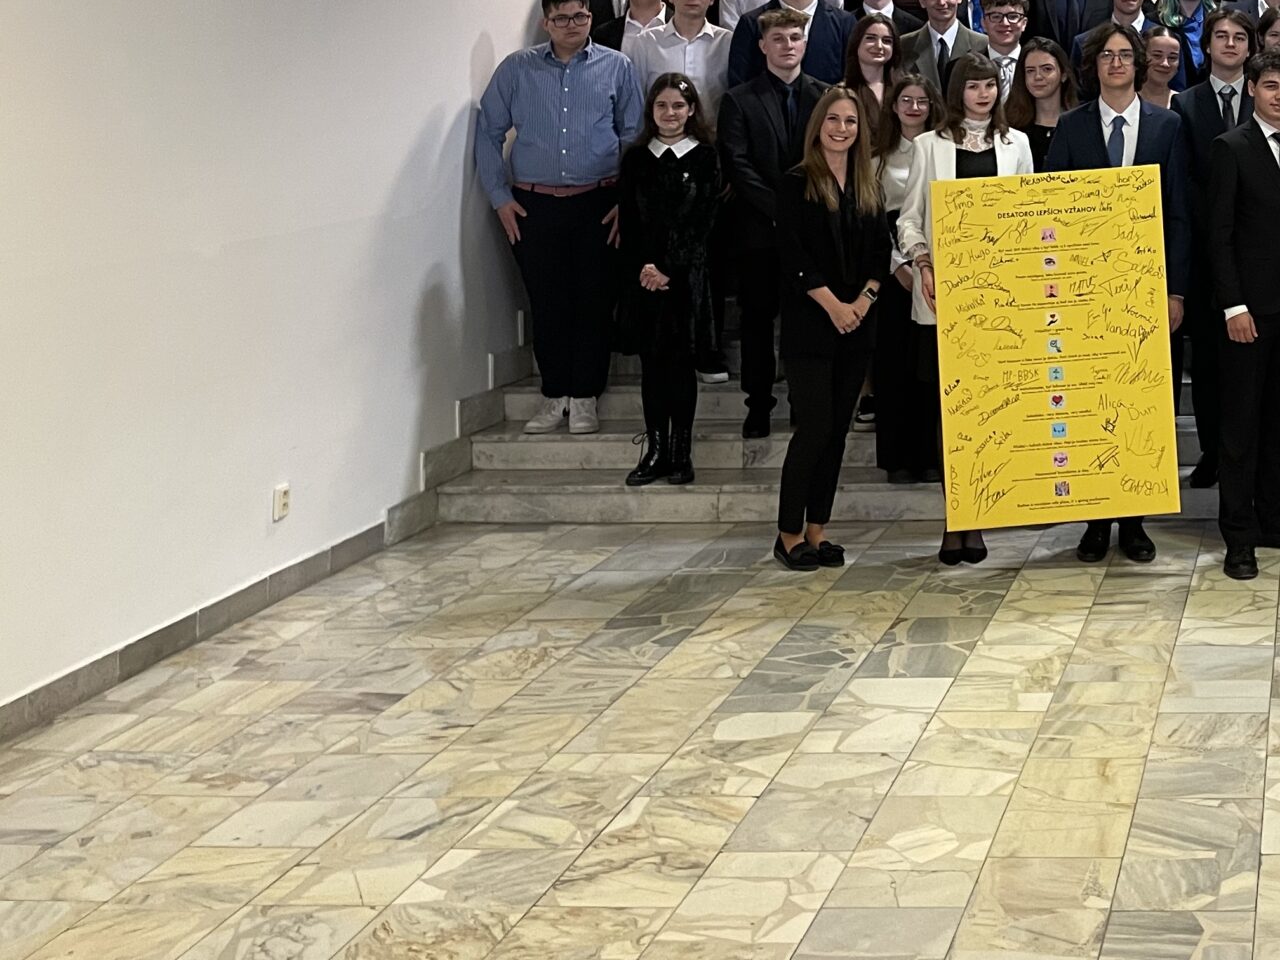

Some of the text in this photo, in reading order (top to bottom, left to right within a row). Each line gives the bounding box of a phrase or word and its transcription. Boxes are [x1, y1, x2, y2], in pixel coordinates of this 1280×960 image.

[997, 210, 1035, 219] DESATORO
[1036, 207, 1063, 217] LEPŠÍCH
[1064, 205, 1097, 214] VZŤAHOV
[967, 248, 991, 264] Hugo
[1105, 321, 1138, 338] Vanda
